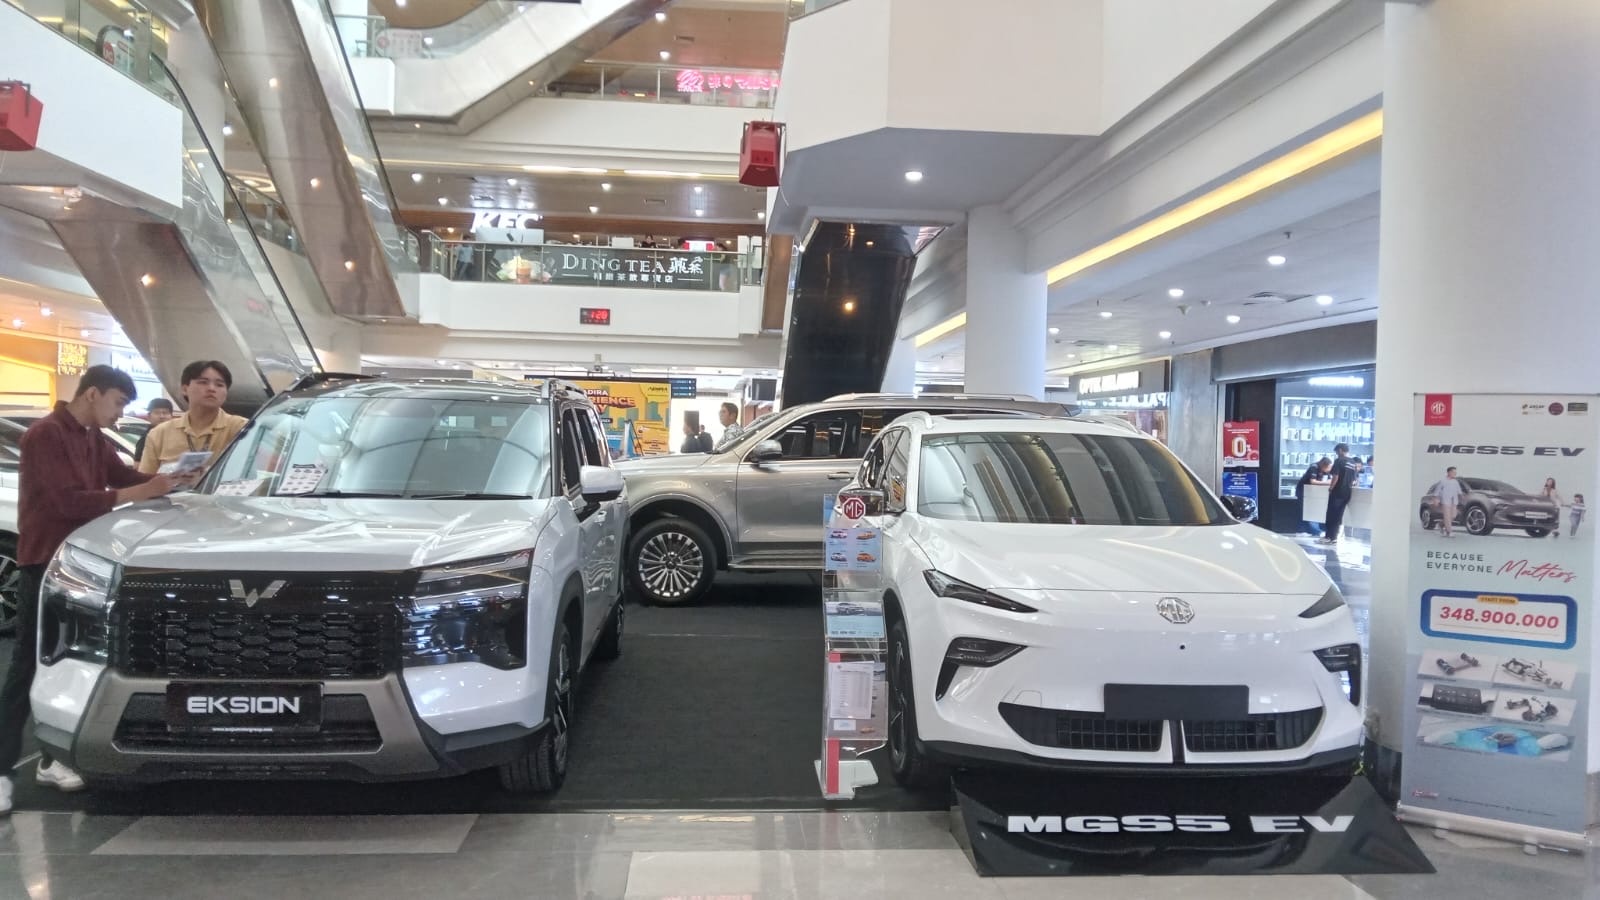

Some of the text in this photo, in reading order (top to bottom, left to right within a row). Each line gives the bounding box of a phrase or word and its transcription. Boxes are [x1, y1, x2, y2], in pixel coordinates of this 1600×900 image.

[470, 212, 540, 232] KFC
[562, 253, 620, 271] DING
[625, 259, 666, 273] TEA
[591, 396, 637, 407] RIENCE
[1427, 444, 1586, 457] MGS5 EV
[844, 499, 864, 518] MG
[1427, 551, 1484, 562] BECAUSE
[1426, 559, 1577, 583] EVERYONE Matters
[1156, 597, 1195, 624] MG
[1440, 606, 1559, 629] 348.900.000
[187, 696, 300, 714] EKSION
[1007, 815, 1355, 833] MGS5 EV
